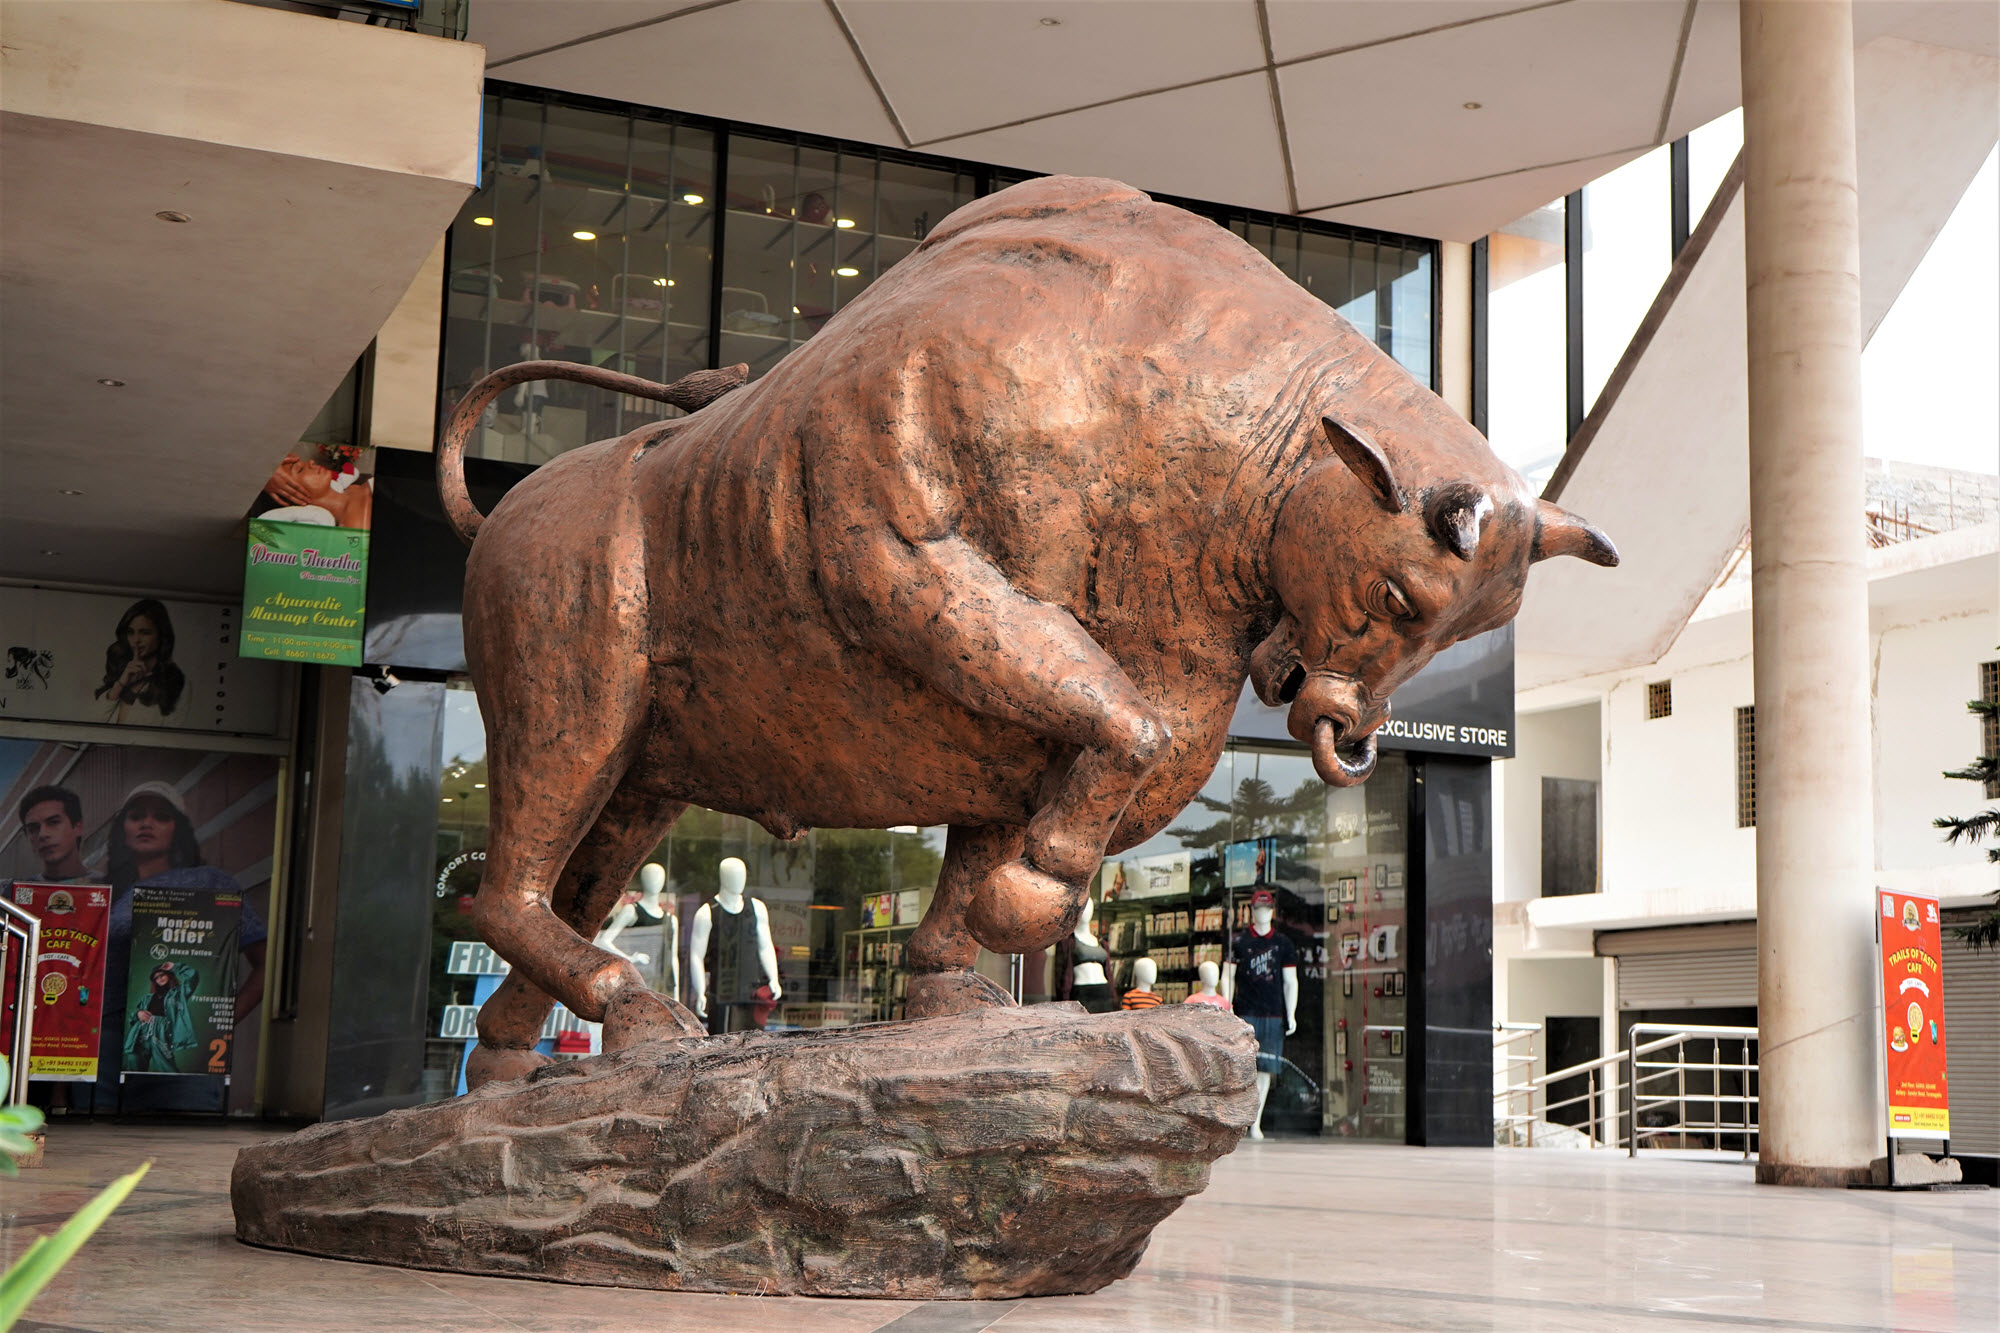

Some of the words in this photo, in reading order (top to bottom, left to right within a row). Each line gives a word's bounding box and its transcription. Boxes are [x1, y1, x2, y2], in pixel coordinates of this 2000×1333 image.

[250, 543, 298, 566] Prana
[300, 547, 361, 572] Theertha
[247, 606, 310, 626] Massage
[312, 611, 358, 628] Center
[1376, 720, 1456, 742] EXCLUSIVE
[1459, 726, 1507, 747] STORE
[436, 853, 468, 898] COMFORT
[470, 851, 487, 861] CO
[157, 916, 213, 930] Monsoon
[46, 939, 71, 949] CAFE
[54, 928, 68, 938] OF
[70, 929, 99, 949] TASTE
[162, 928, 206, 944] Offer
[450, 943, 508, 973] FRE
[1250, 949, 1273, 969] GAME
[1888, 947, 1909, 967] TRAILS
[1910, 946, 1919, 960] OF
[1919, 949, 1938, 974] TASTE
[1906, 960, 1922, 975] CAFE
